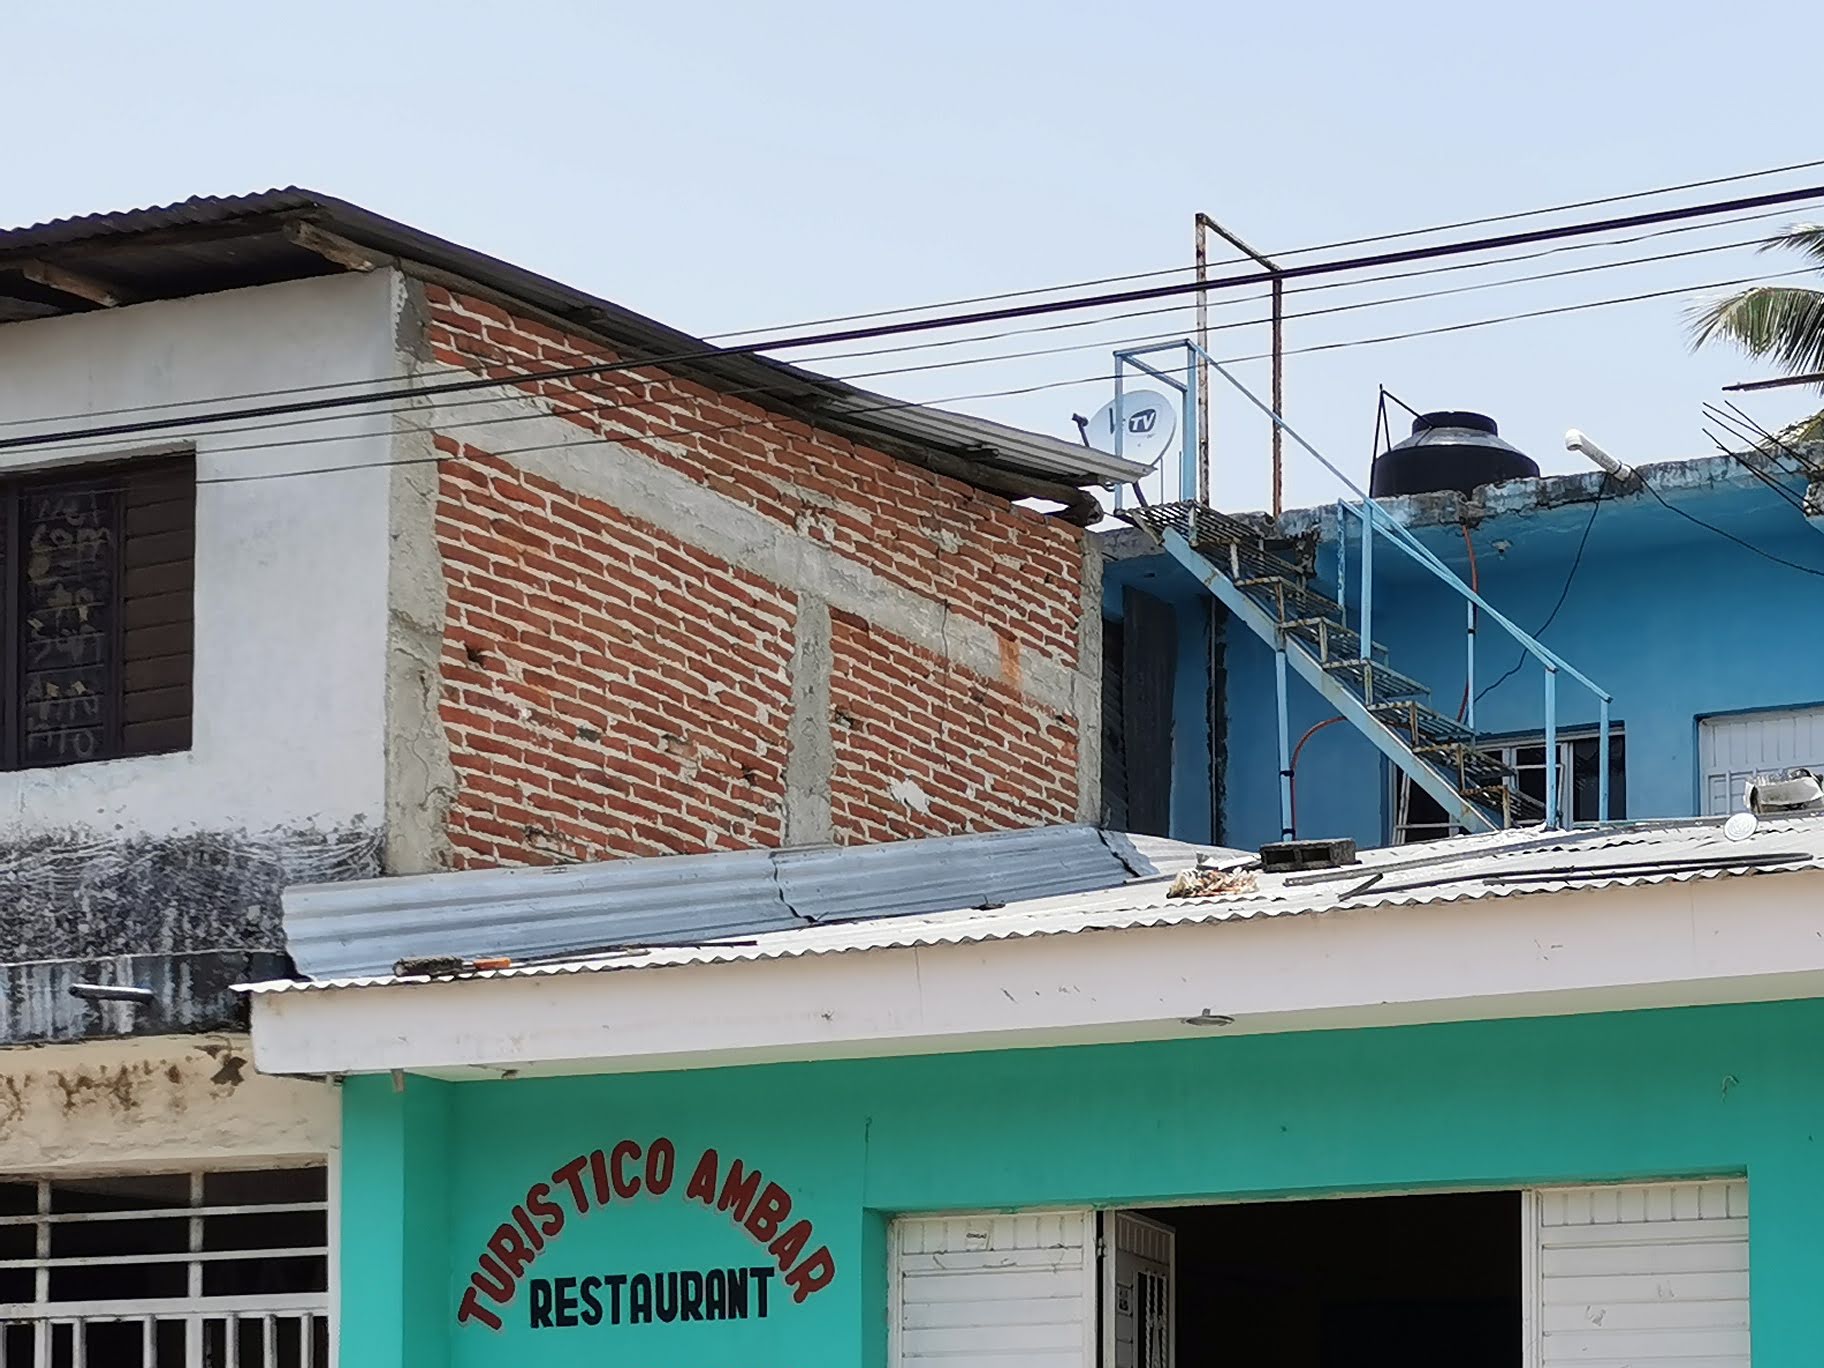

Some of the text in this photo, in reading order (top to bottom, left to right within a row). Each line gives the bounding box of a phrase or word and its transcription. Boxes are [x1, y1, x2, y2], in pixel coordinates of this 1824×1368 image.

[457, 1136, 837, 1331] TURISTICO AMBAR
[529, 1266, 776, 1330] RESTAURANT
